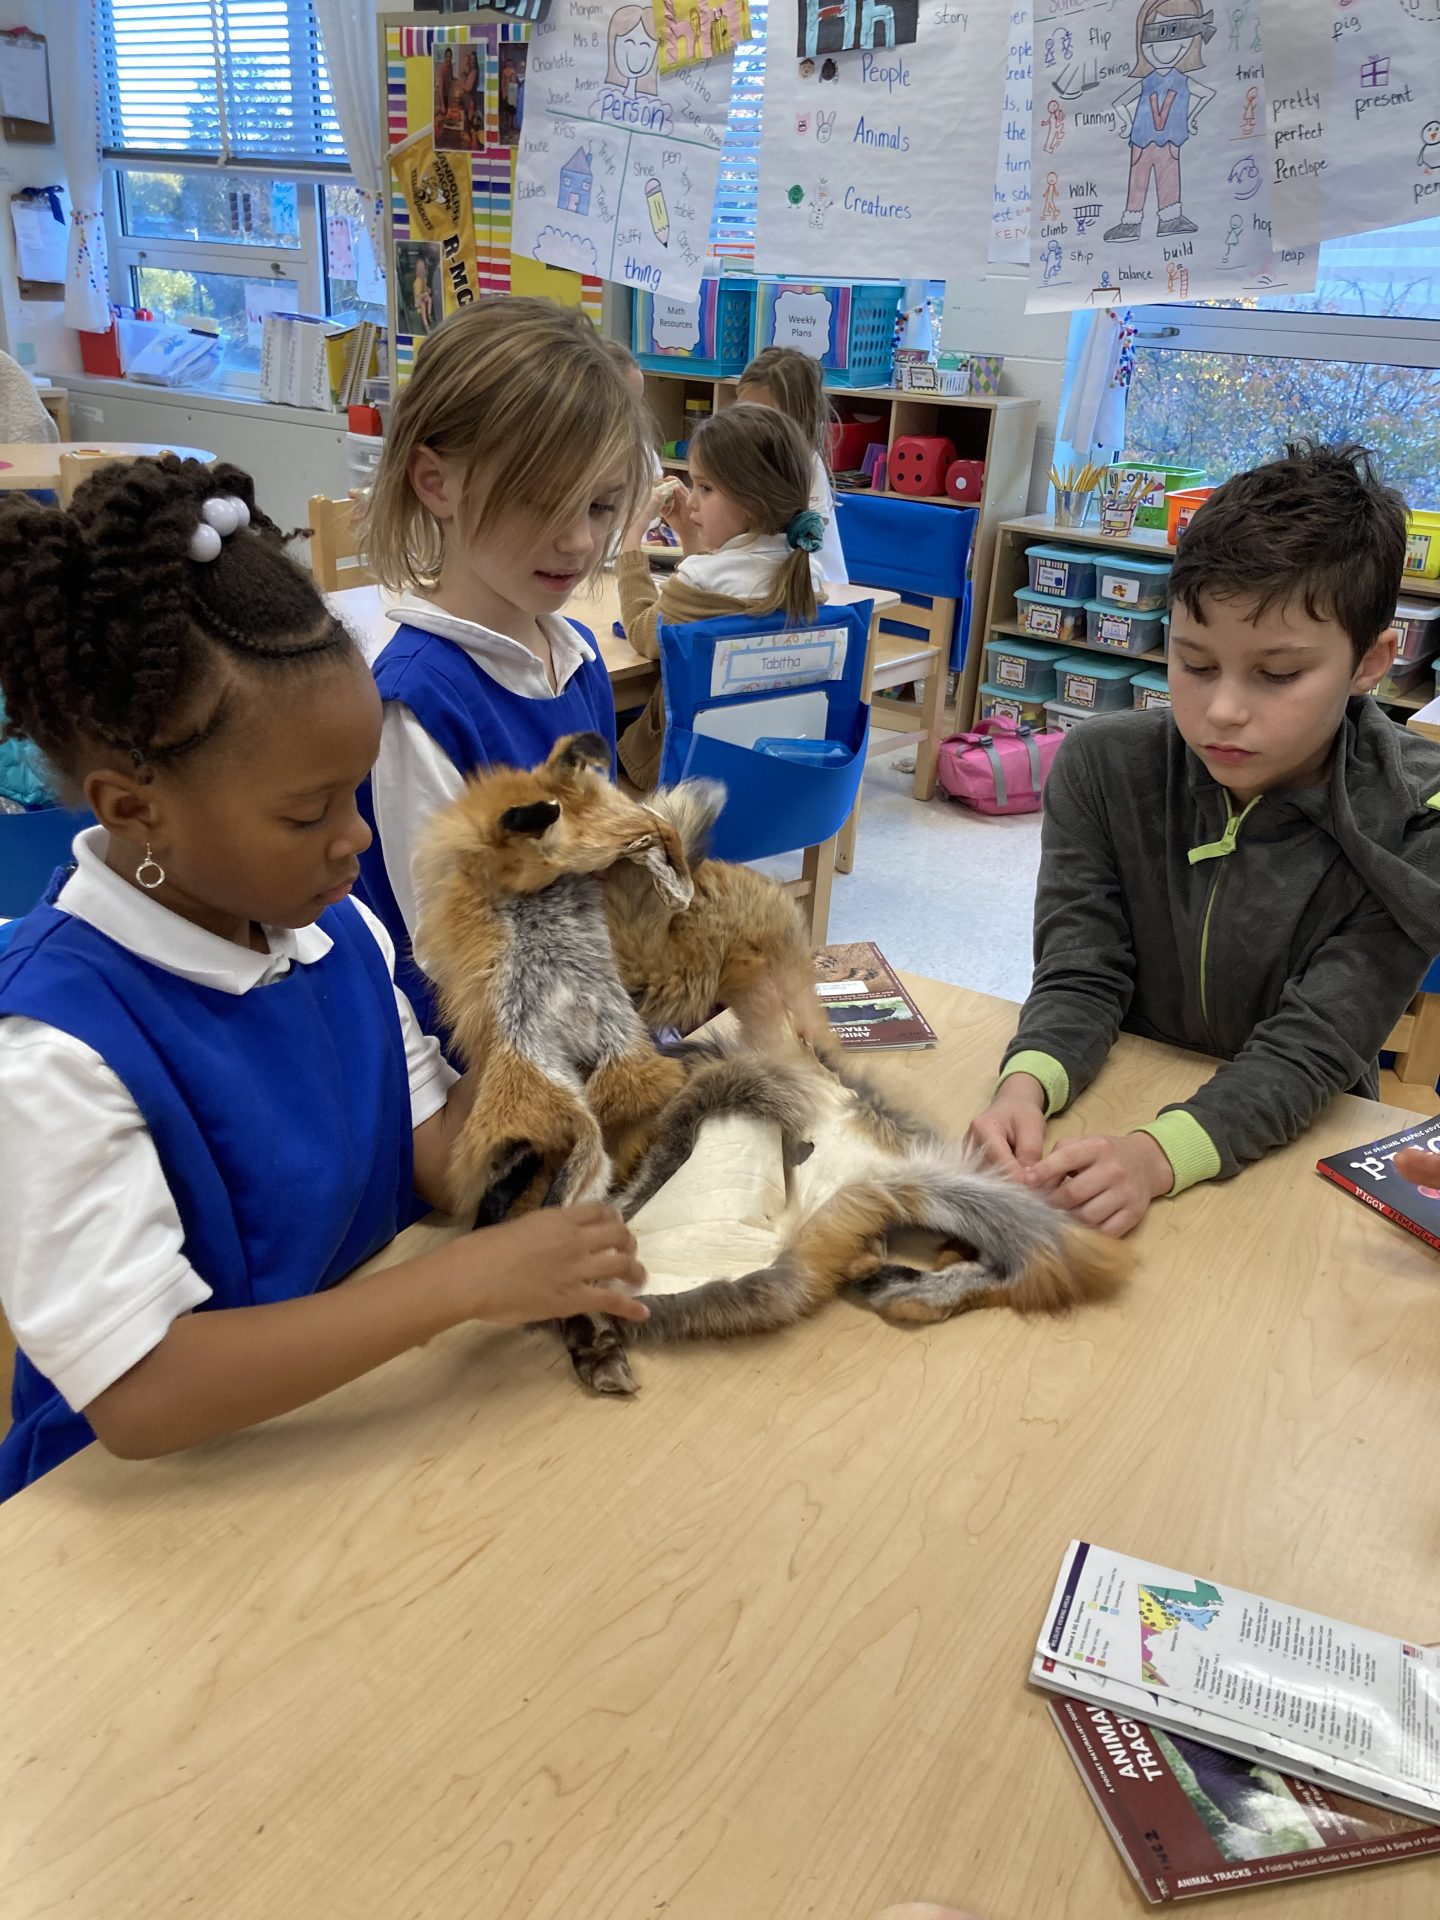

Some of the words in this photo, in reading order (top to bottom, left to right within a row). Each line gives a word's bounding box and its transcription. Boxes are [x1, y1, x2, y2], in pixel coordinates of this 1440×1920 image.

[1089, 27, 1112, 51] flip
[1332, 16, 1362, 42] pig
[573, 33, 588, 48] Mrs
[591, 32, 600, 48] B
[532, 50, 575, 73] Charlotte
[1099, 62, 1131, 80] swing
[862, 53, 912, 94] People
[1235, 64, 1264, 81] twirl
[1150, 88, 1178, 131] V
[1272, 87, 1321, 122] pretty
[1355, 84, 1415, 120] present
[681, 99, 702, 128] Zoe
[1074, 111, 1117, 132] running
[853, 116, 911, 152] Animals
[1004, 121, 1027, 140] the
[1274, 122, 1324, 149] perfect
[524, 137, 549, 153] house
[662, 151, 682, 169] pen
[1274, 158, 1328, 184] Penelope
[844, 186, 912, 220] Creatures
[1041, 224, 1067, 238] climb
[1070, 251, 1094, 265] skip
[1163, 242, 1193, 260] build
[1281, 250, 1305, 267] leap
[443, 234, 473, 307] R-MC
[624, 256, 662, 291] thing
[1118, 267, 1154, 281] balance
[667, 305, 686, 317] Math
[788, 314, 817, 327] Weekly
[659, 318, 693, 330] Resources
[791, 328, 812, 338] Plans
[761, 656, 800, 671] Tabitha
[1355, 1186, 1385, 1211] PIGGY
[1388, 1208, 1437, 1245] PERMANENT
[1065, 1703, 1078, 1722] GUIDE
[1095, 1762, 1111, 1788] POCKET
[1176, 1874, 1213, 1888] ANIMAL
[1213, 1867, 1251, 1882] TRACKS
[1266, 1860, 1292, 1874] Folding
[1292, 1856, 1317, 1868] Pocket
[1318, 1852, 1339, 1863] Guide
[1340, 1850, 1348, 1860] to
[1349, 1848, 1361, 1858] the
[1361, 1843, 1385, 1856] Tracks
[1392, 1838, 1412, 1851] Signs
